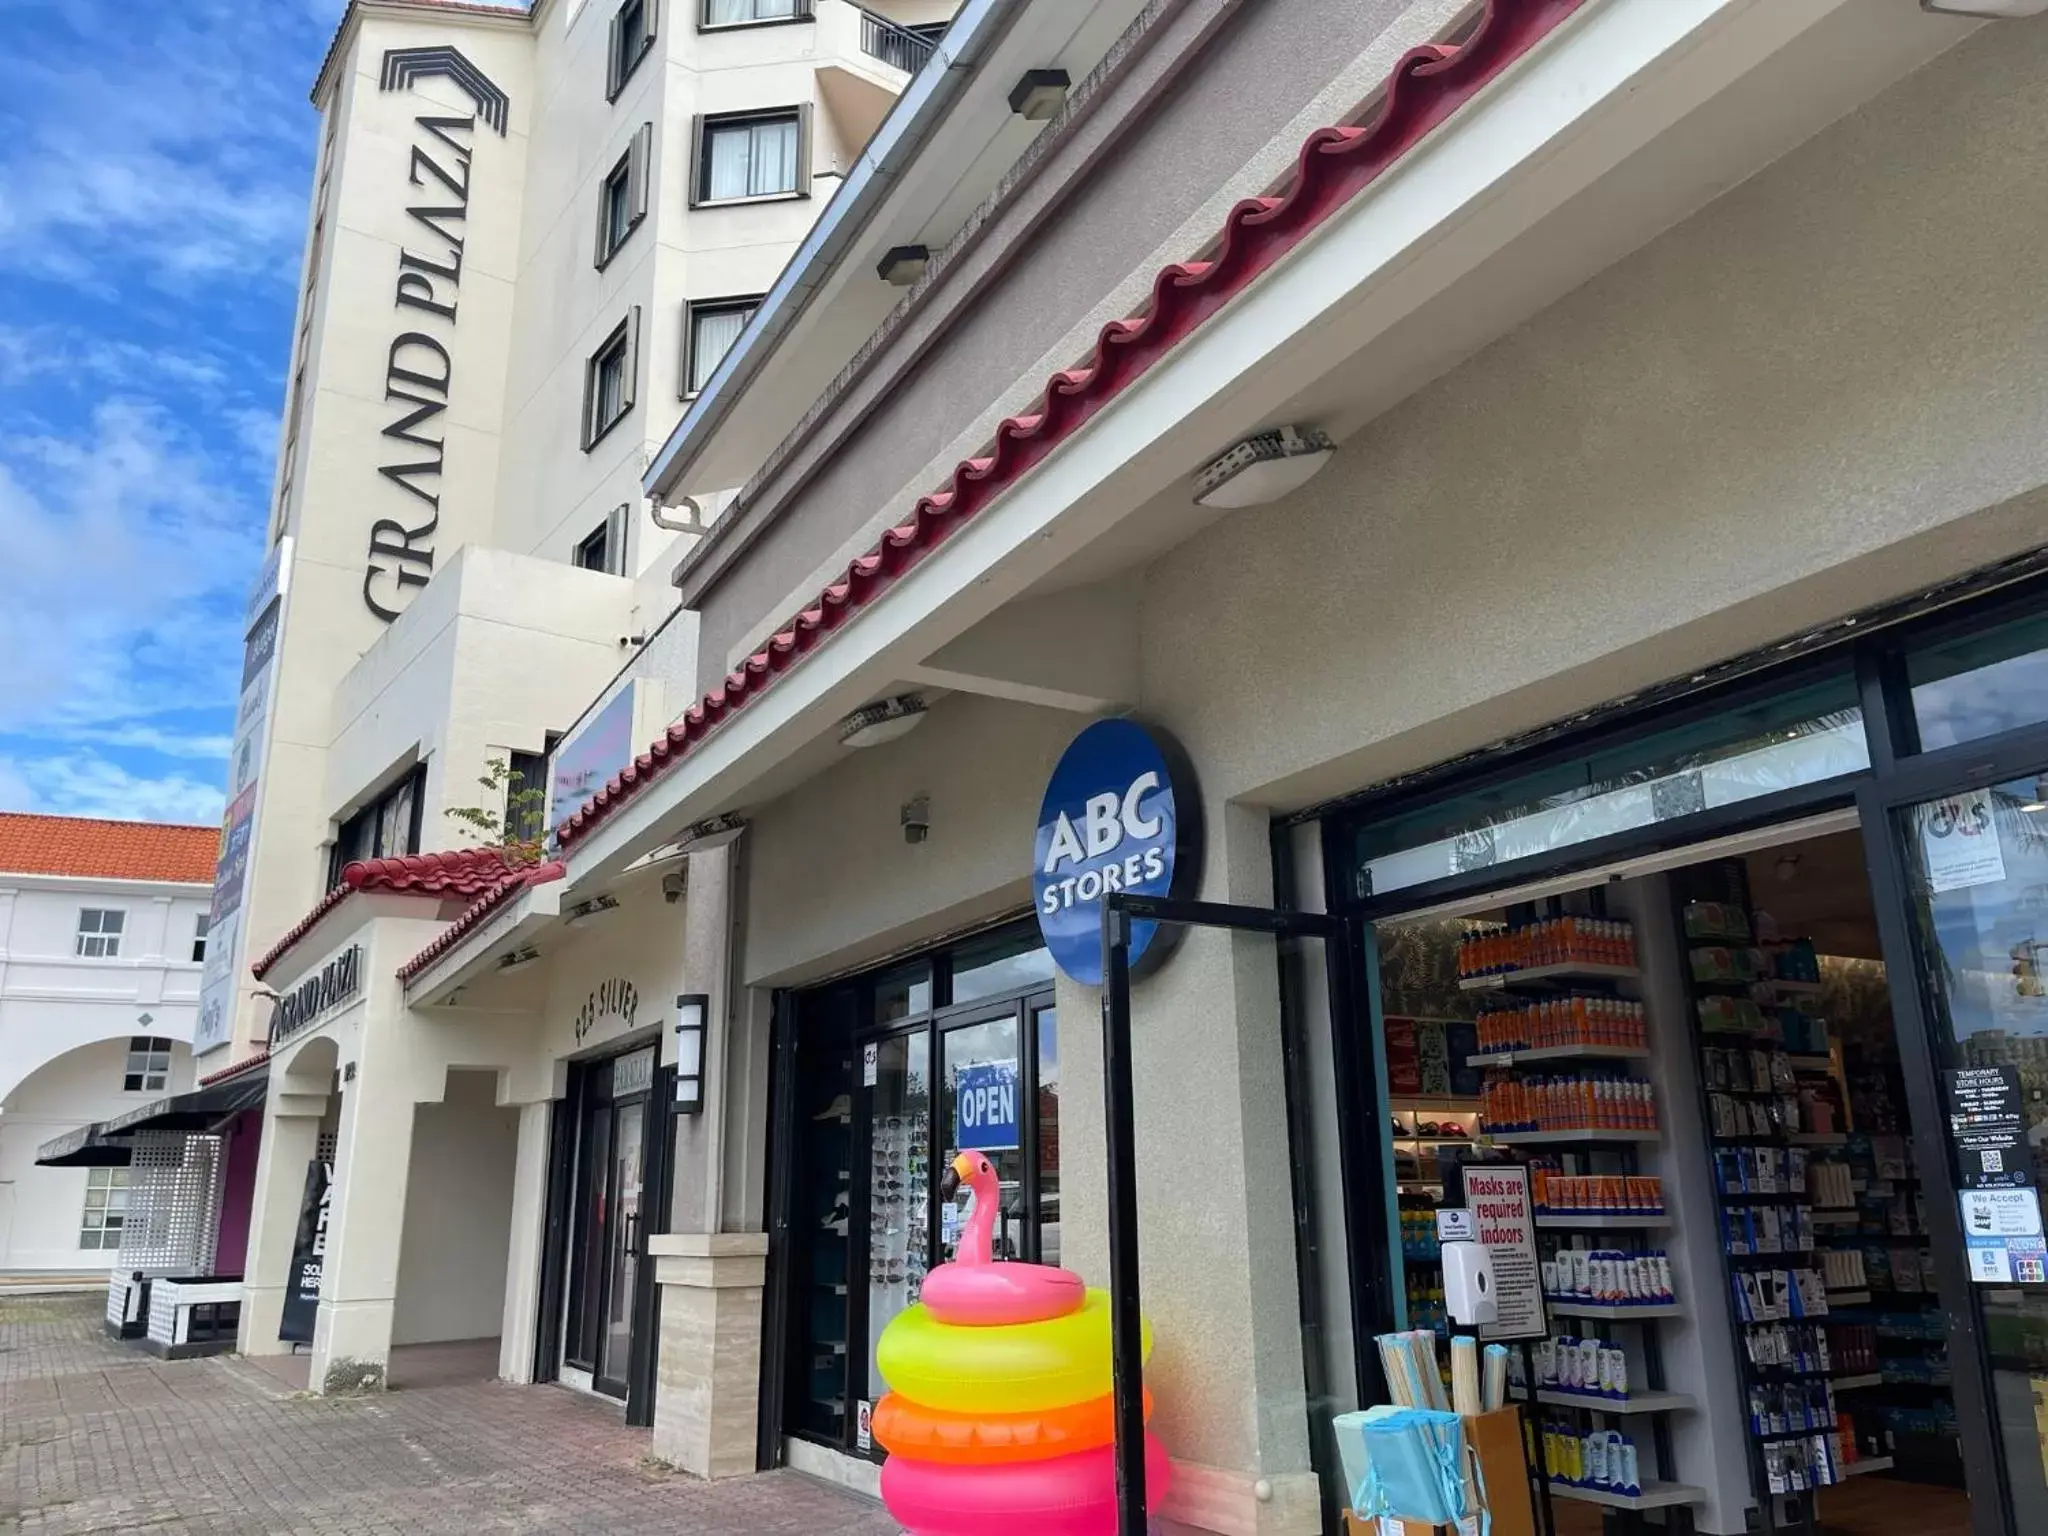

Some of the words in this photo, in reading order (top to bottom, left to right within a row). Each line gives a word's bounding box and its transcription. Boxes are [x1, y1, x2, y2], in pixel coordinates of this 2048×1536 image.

[394, 113, 476, 326] PLAZA
[363, 331, 452, 624] GRAND
[1043, 771, 1162, 874] ABC
[1042, 847, 1164, 915] STORES
[599, 976, 639, 1028] SILVER
[962, 1086, 1014, 1128] OPEN
[1469, 1175, 1503, 1196] Masks
[1506, 1179, 1523, 1195] are
[1972, 1194, 1988, 1203] We
[1989, 1193, 2024, 1203] Accept
[1476, 1198, 1524, 1227] required
[1480, 1223, 1524, 1245] indoors
